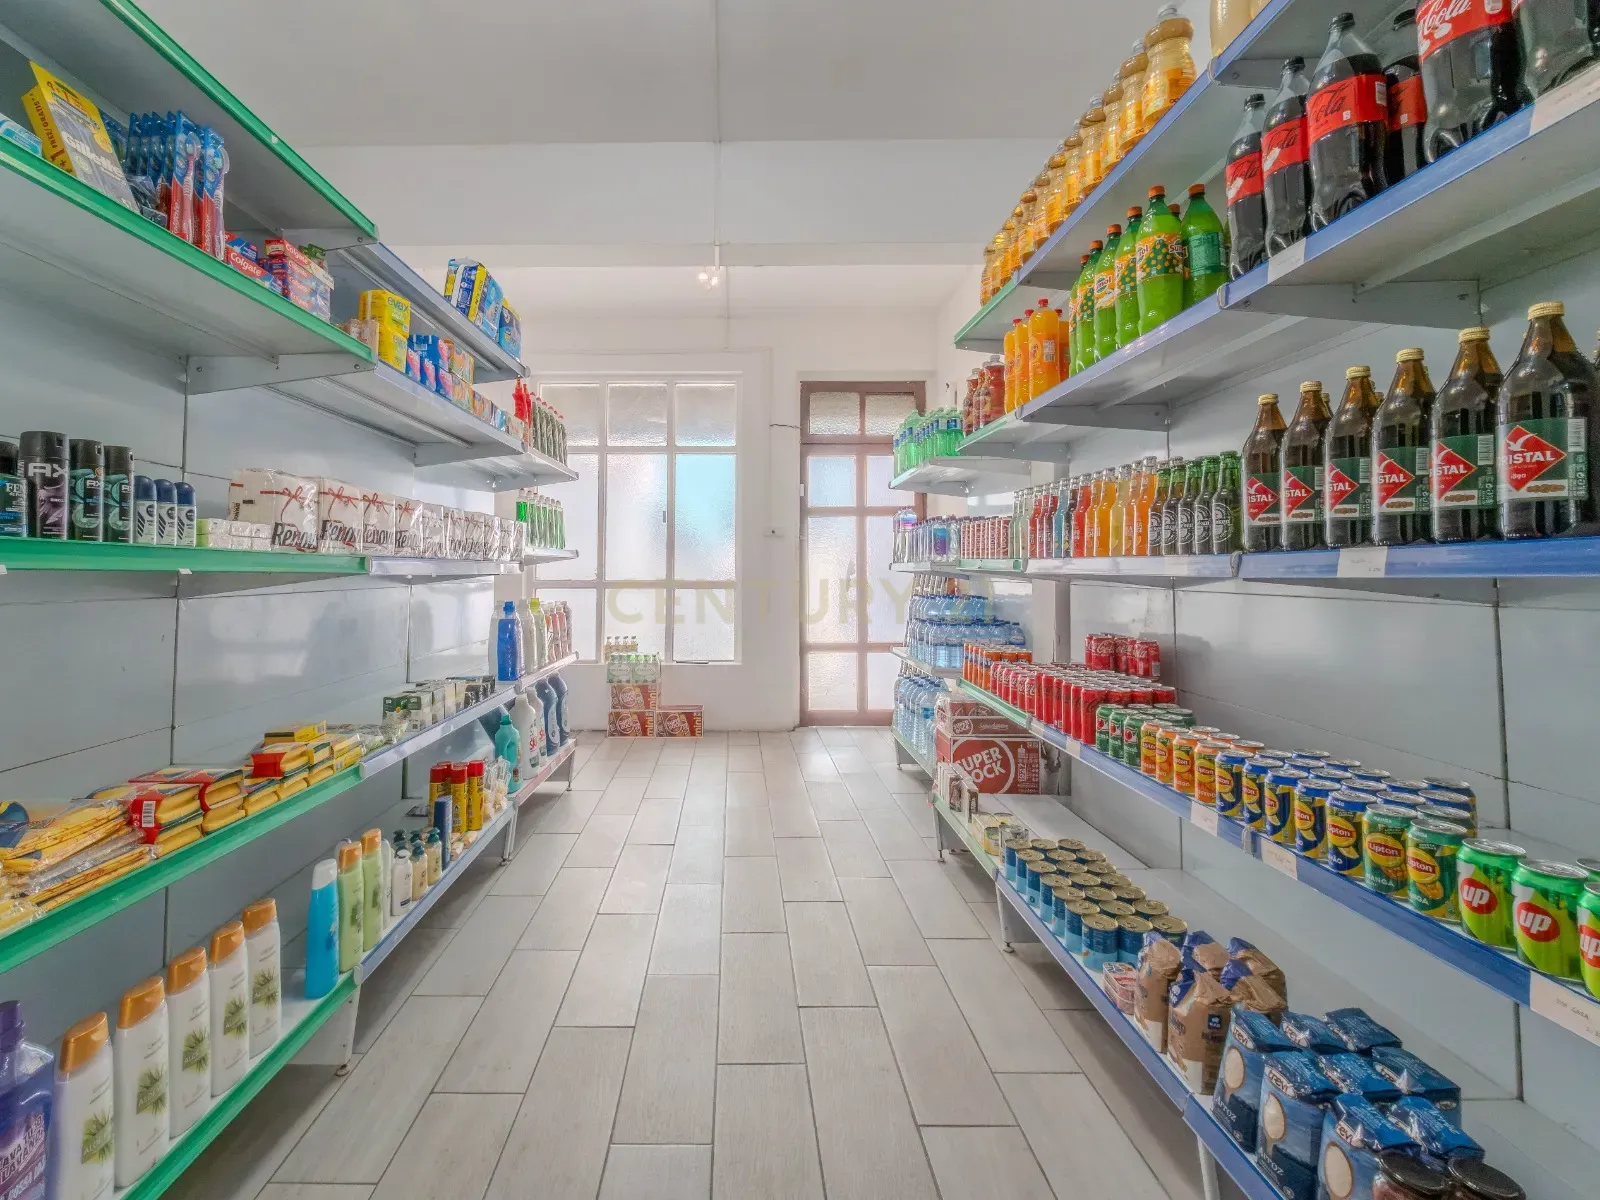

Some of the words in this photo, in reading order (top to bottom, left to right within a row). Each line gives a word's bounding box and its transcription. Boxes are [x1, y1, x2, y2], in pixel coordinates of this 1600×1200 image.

[230, 252, 262, 277] Colgate
[285, 243, 309, 265] Colgate
[645, 715, 654, 736] mini
[693, 715, 702, 736] mini
[970, 760, 1006, 783] OCK
[1368, 841, 1400, 856] Lipton
[1268, 1069, 1290, 1092] trevi
